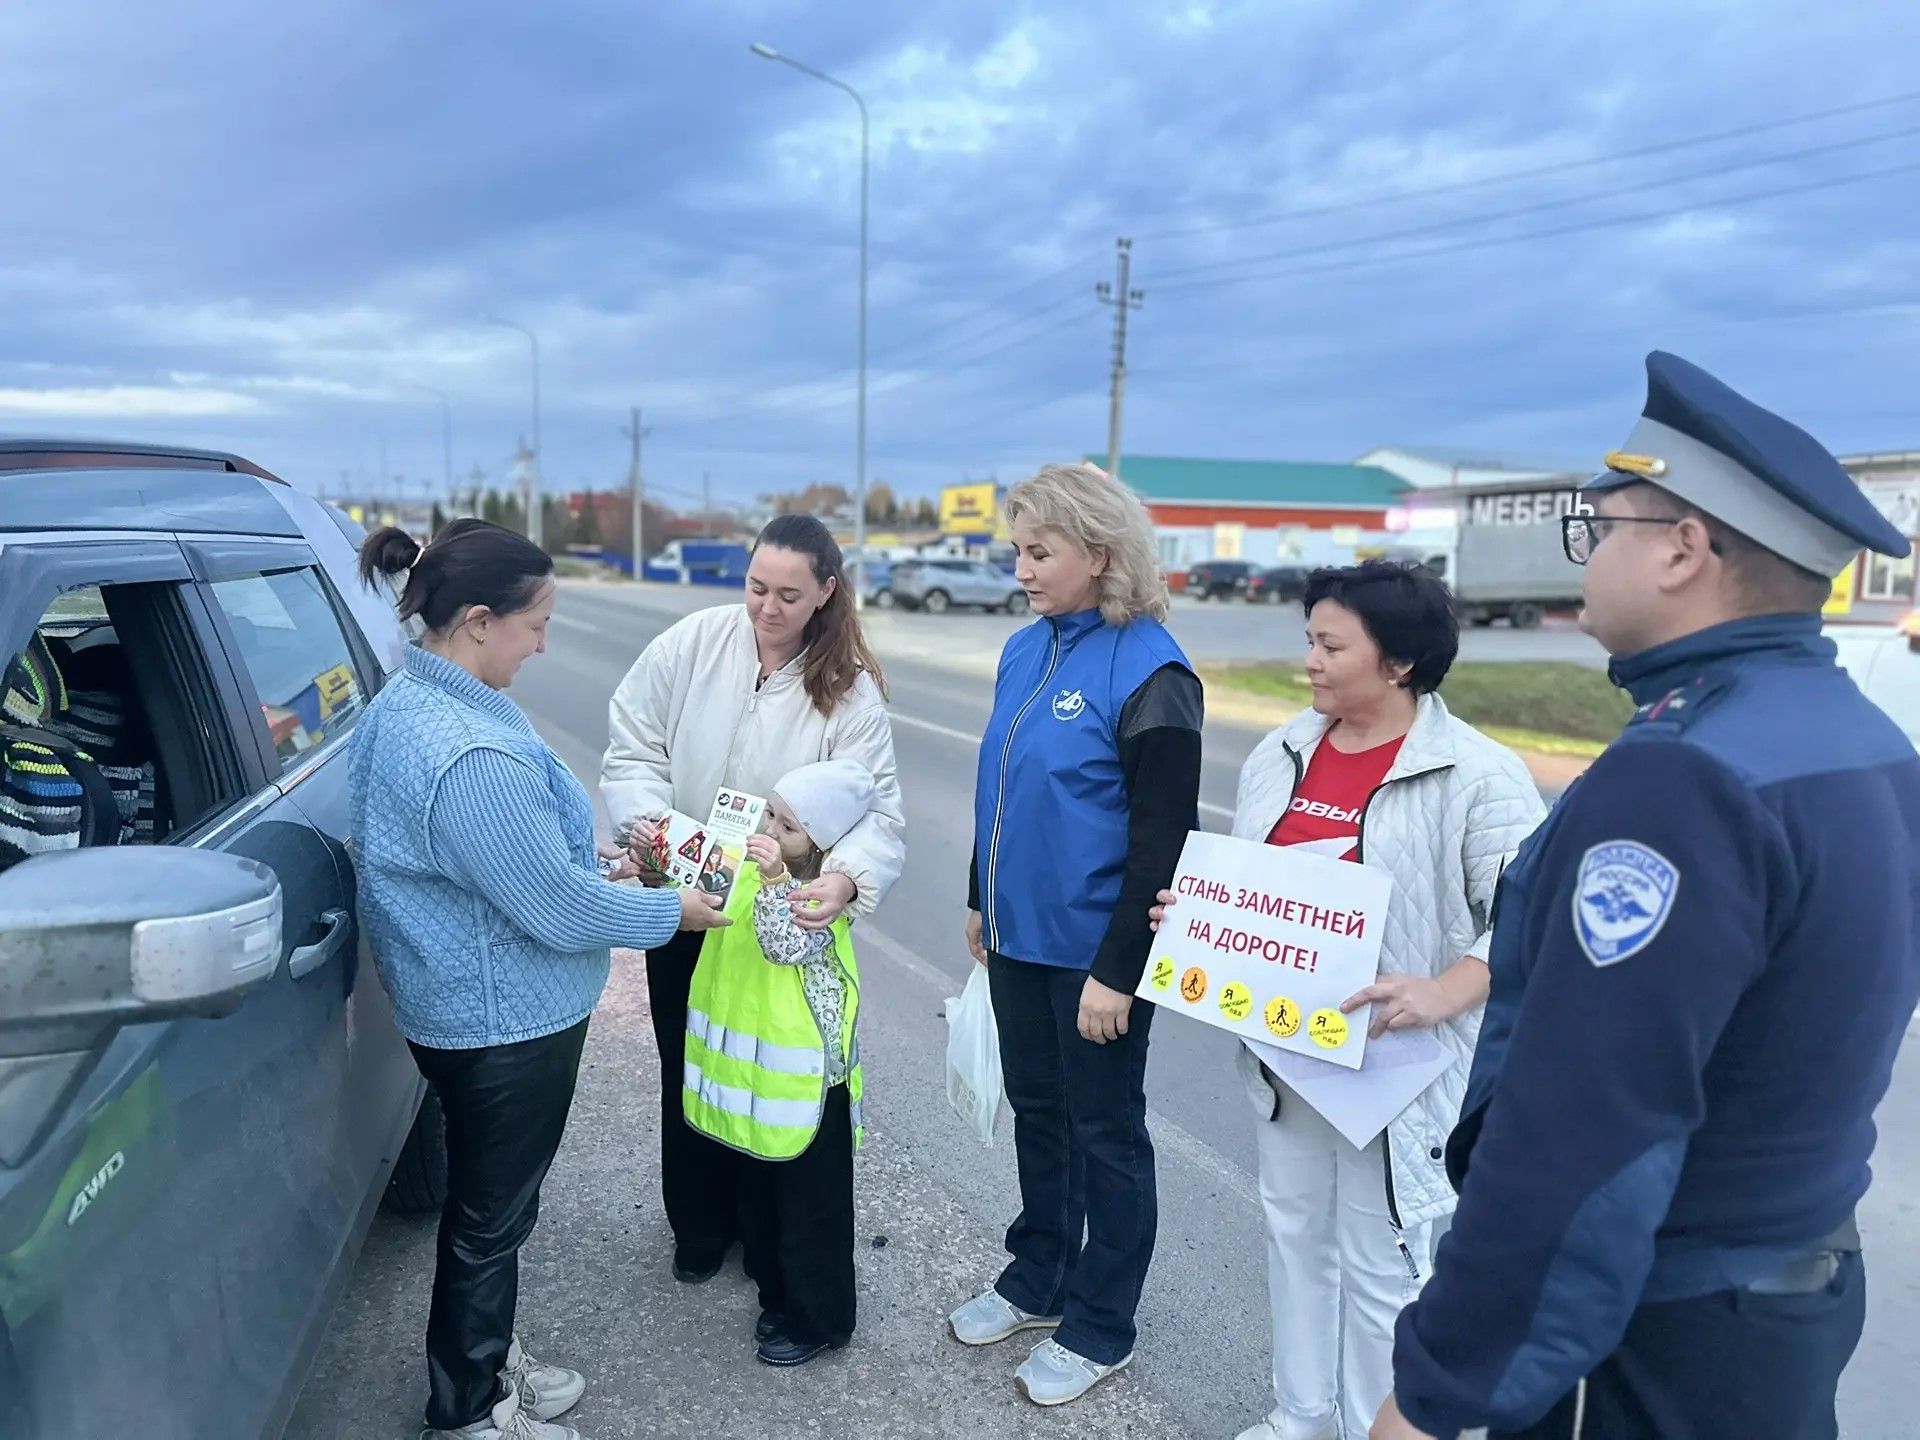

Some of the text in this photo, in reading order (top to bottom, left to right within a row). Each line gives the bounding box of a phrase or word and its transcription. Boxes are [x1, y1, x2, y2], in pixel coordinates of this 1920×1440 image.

[714, 810, 751, 827] ПАМЯТКА
[1288, 797, 1361, 825] рвы
[1178, 875, 1366, 939] СТАНЬ ЗАМЕТНЕЙ
[1187, 918, 1319, 973] НА ДОРОГЕ!
[1224, 988, 1234, 1000] Я
[1315, 1015, 1327, 1027] Я
